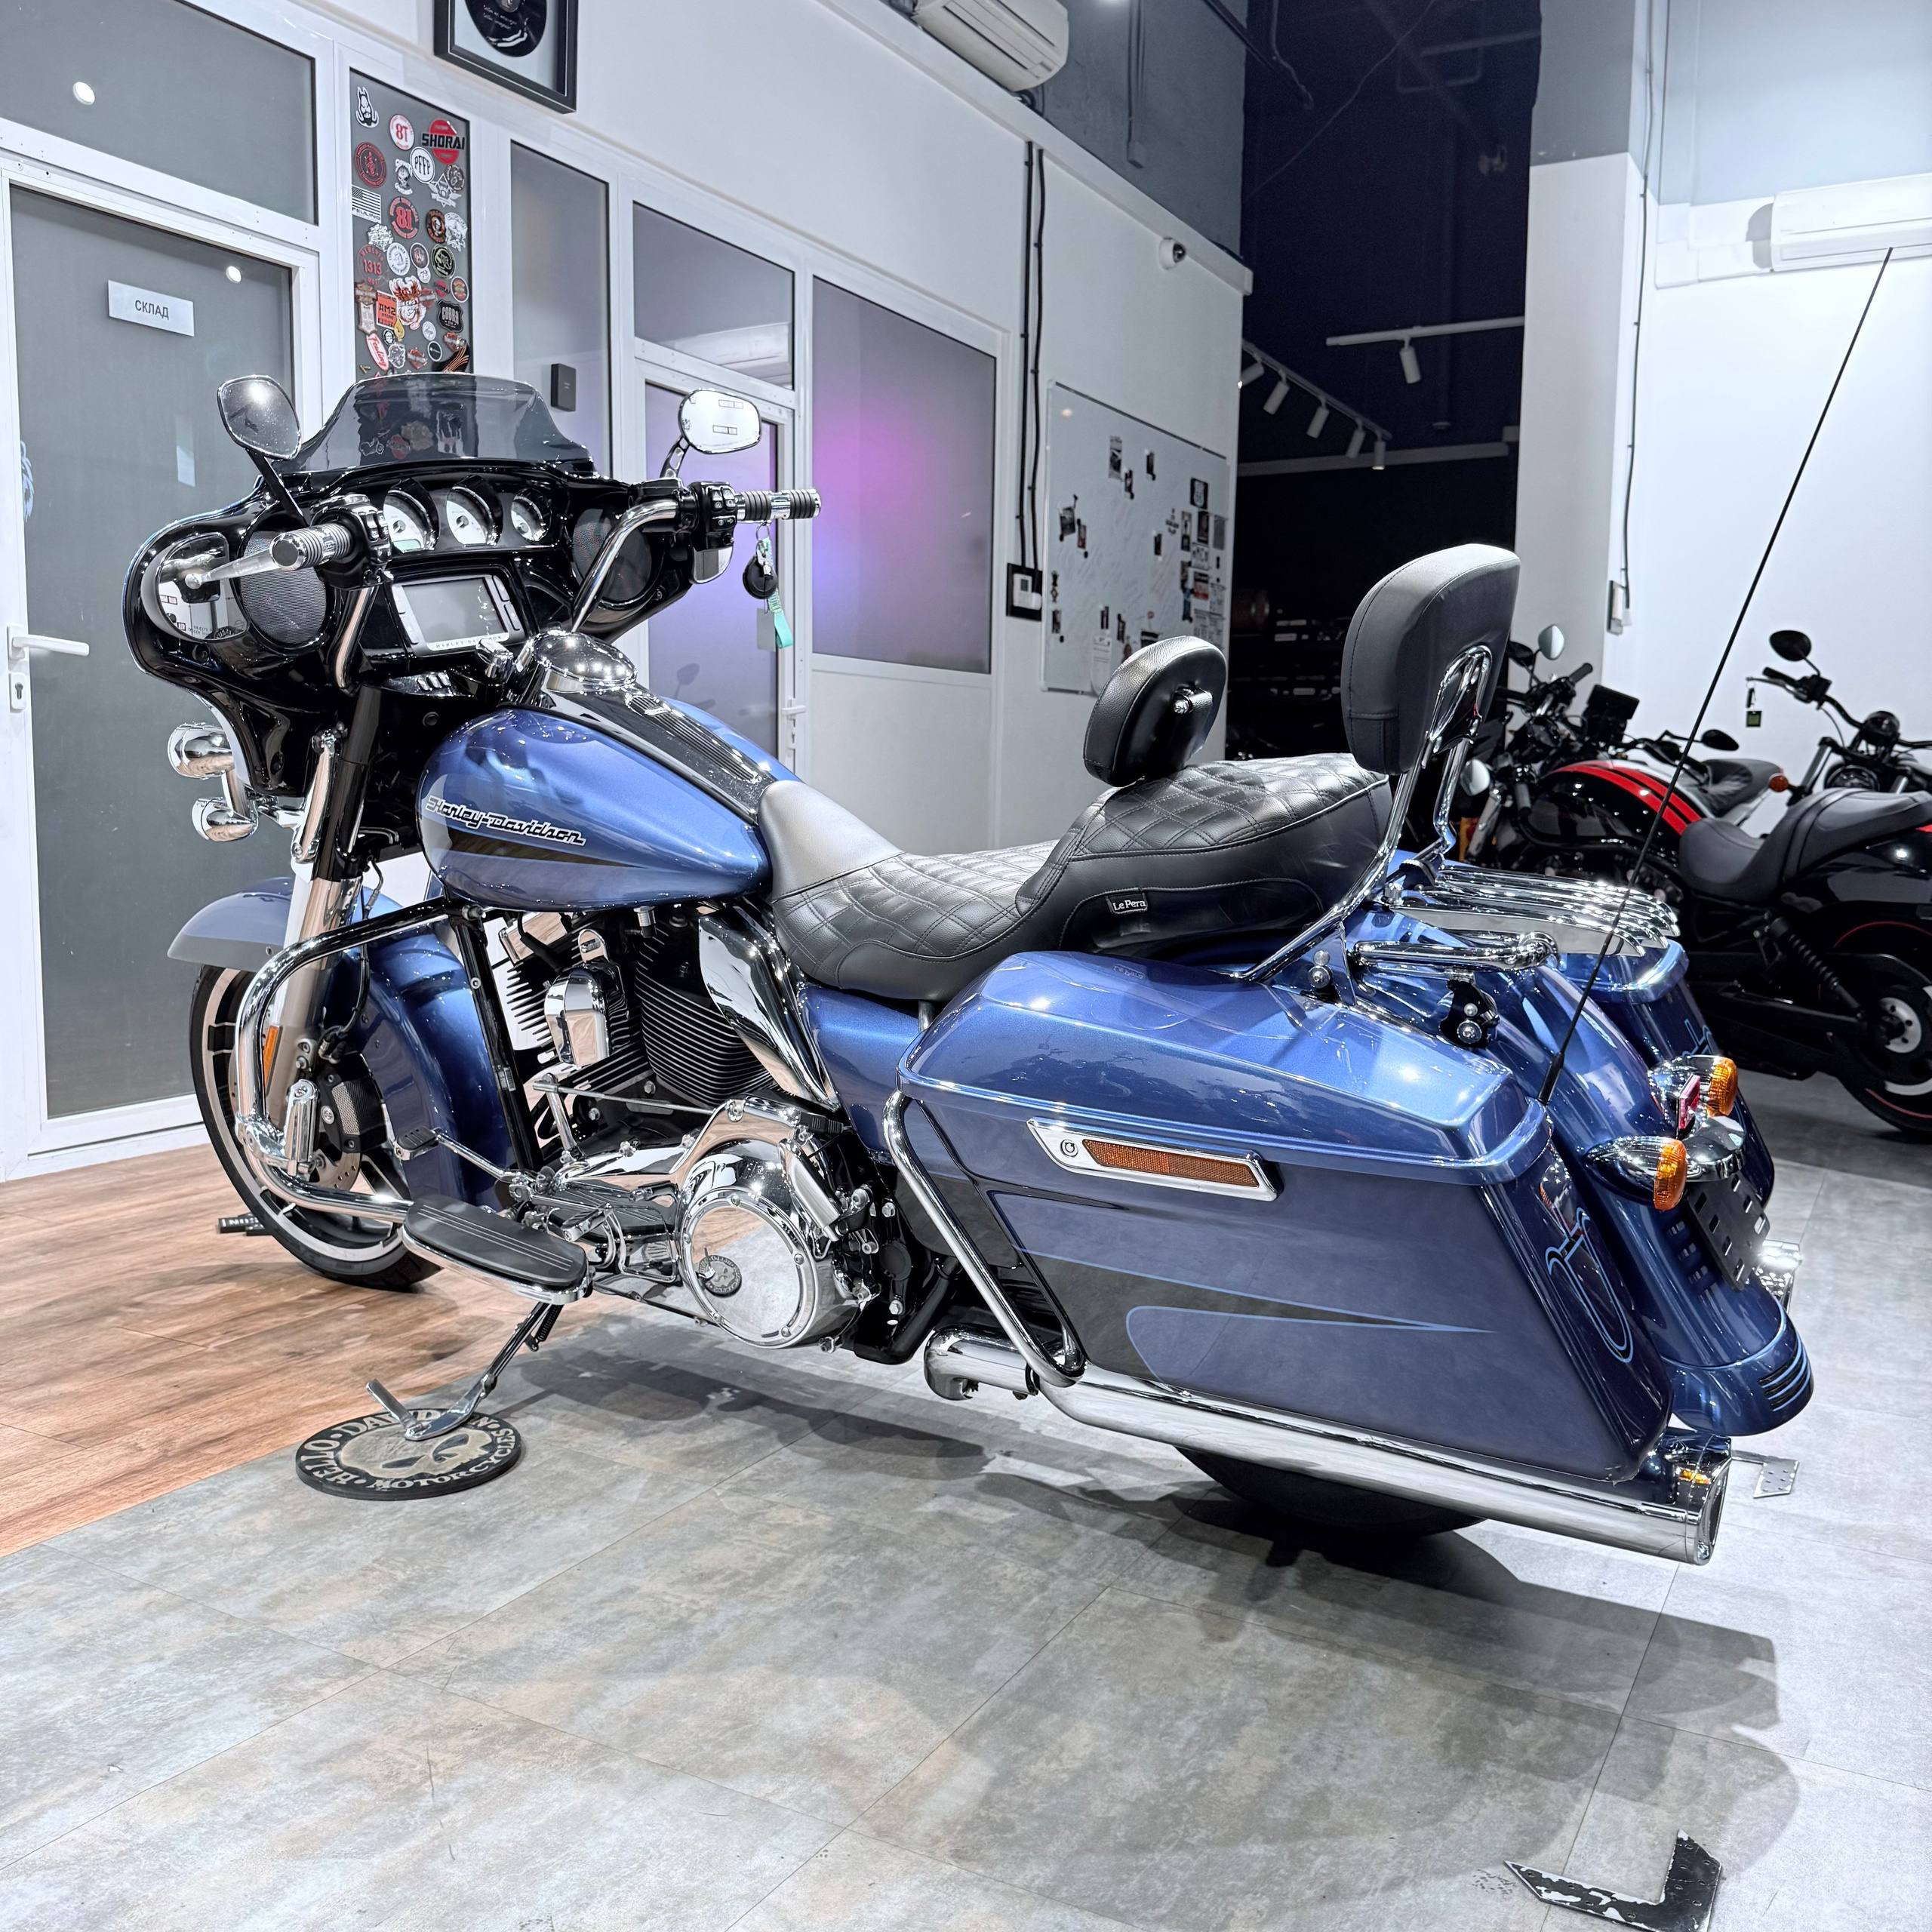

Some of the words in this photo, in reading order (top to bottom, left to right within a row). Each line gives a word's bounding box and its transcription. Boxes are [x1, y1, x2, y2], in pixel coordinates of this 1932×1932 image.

[422, 133, 465, 149] SHORAI
[414, 155, 431, 175] PFFP
[352, 207, 380, 220] FEULING
[395, 206, 413, 230] 81
[363, 259, 382, 275] 1313
[134, 300, 170, 320] СКЛАД
[426, 795, 586, 846] Harley-Davidson
[1124, 900, 1146, 908] Pera
[300, 1439, 361, 1484] HELLO
[365, 1428, 516, 1492] MOTORCYCLES
